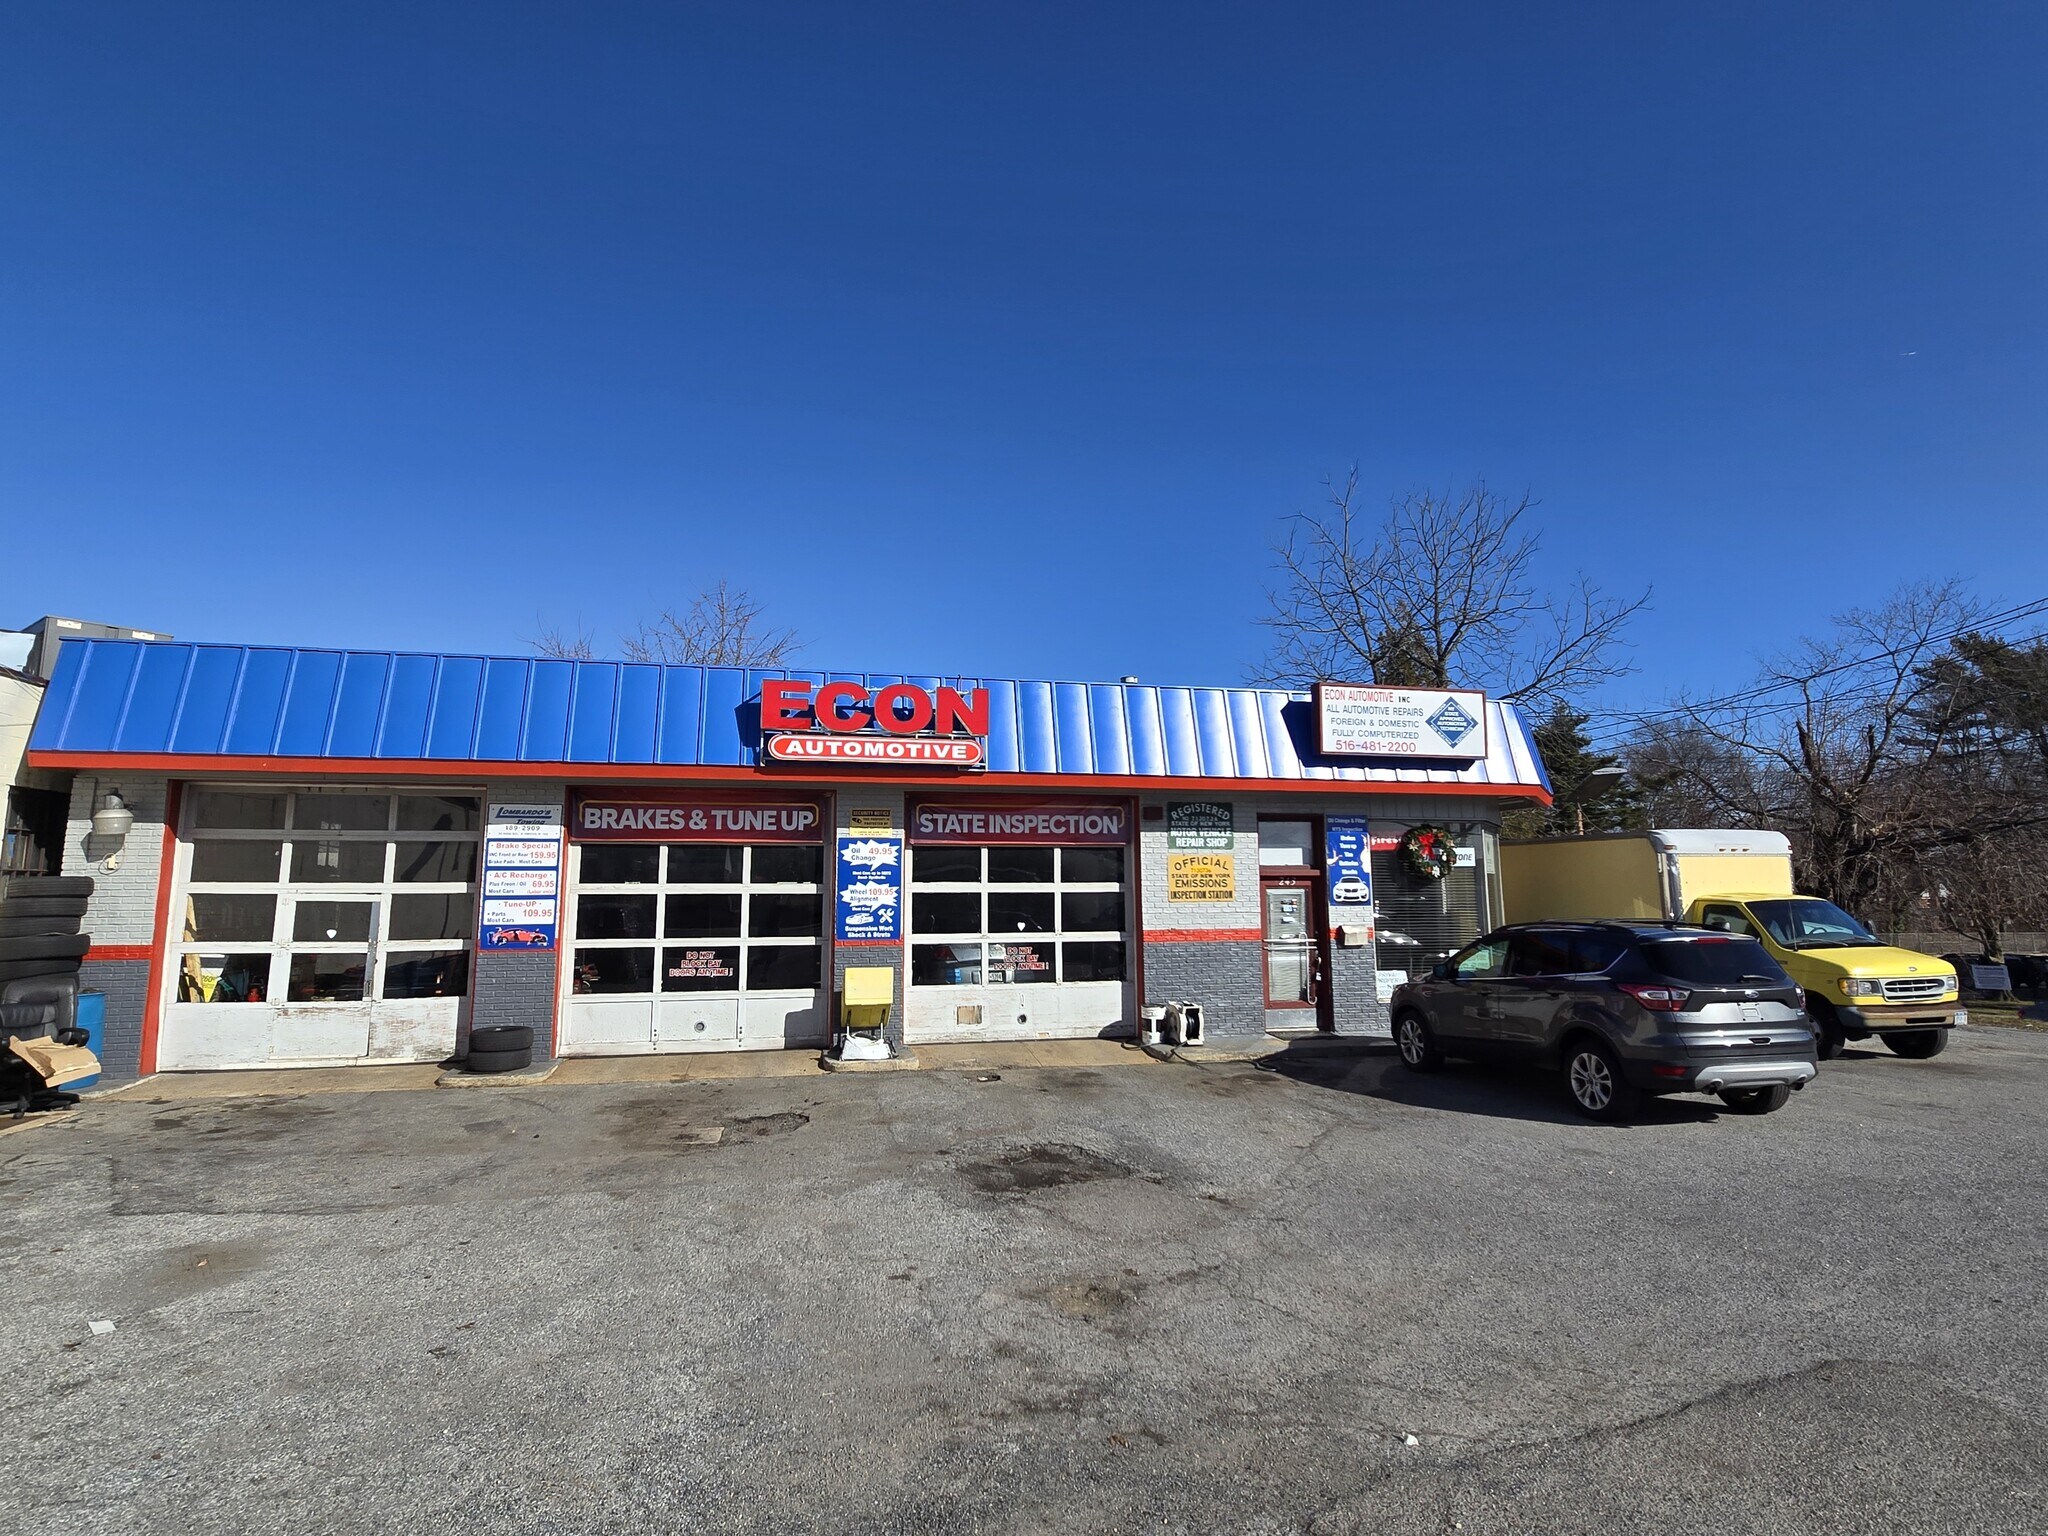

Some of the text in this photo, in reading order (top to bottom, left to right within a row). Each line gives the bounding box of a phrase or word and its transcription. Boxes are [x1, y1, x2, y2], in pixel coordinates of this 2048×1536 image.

[1324, 689, 1346, 700] ECON
[1348, 690, 1394, 702] AUTOMOTIVE
[761, 679, 990, 736] ECON
[1326, 704, 1340, 713] ALL
[1342, 705, 1390, 716] AUTOMOTIVE
[1392, 707, 1424, 716] REPAIRS
[1330, 718, 1366, 726] FOREIGN
[1378, 720, 1420, 728] DOMESTIC
[1332, 728, 1354, 737] FULLY
[1358, 730, 1419, 740] COMPUTERIZED
[785, 740, 967, 759] AUTOMOTIVE
[1336, 740, 1416, 752] 516-481-2200
[1171, 804, 1230, 820] REGISTERED
[584, 808, 814, 831] BRAKES & TUNE UP
[920, 813, 1118, 834] STATE INSPECTION
[1171, 828, 1232, 837] MOTOR VEHICLE
[1176, 838, 1228, 848] REPAIR SHOP
[1174, 856, 1228, 870] OFFICIAL
[1176, 879, 1228, 888] EMISSIONS
[869, 888, 894, 896] 109.95
[1171, 890, 1232, 899] INSPECTION STATION
[1006, 946, 1018, 954] DO
[1018, 946, 1032, 954] NOT
[669, 968, 696, 976] DOORS
[994, 962, 1016, 970] DOORS
